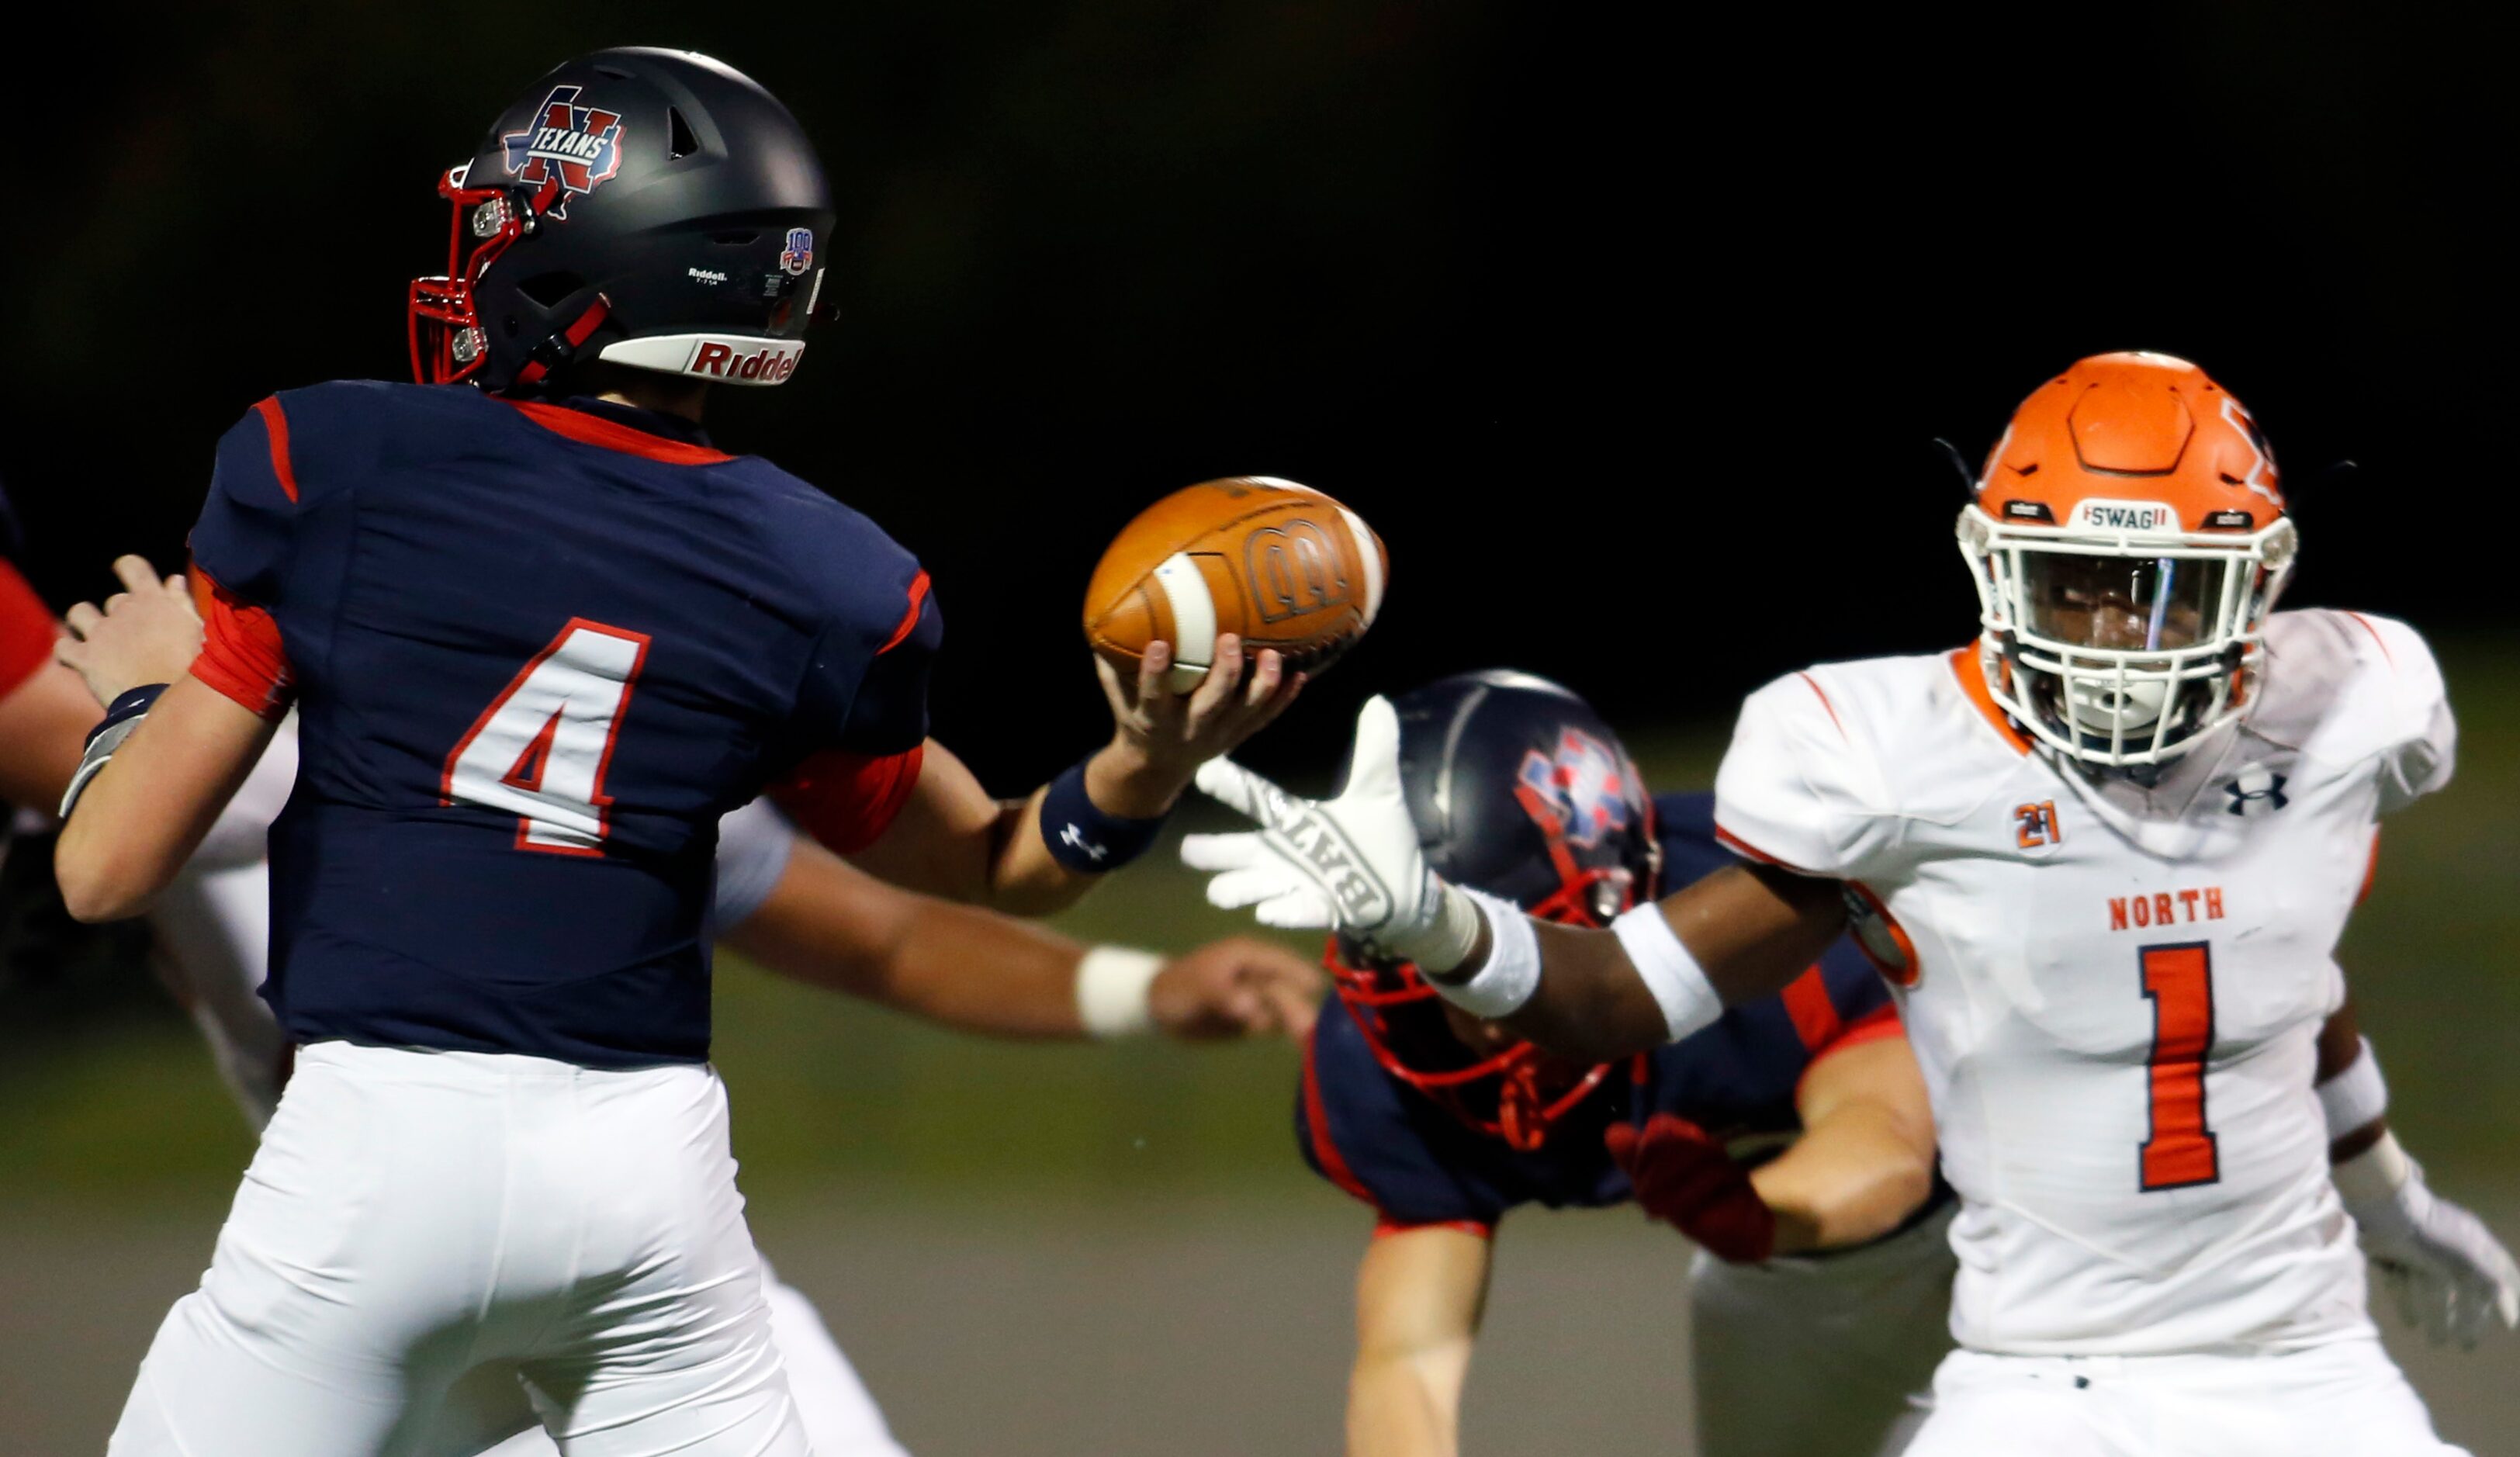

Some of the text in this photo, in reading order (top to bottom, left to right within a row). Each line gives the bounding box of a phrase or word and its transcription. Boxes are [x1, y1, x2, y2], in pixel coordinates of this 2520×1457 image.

[531, 127, 608, 159] TEXANS
[788, 232, 811, 251] 100
[688, 268, 725, 281] Riddell
[438, 616, 652, 857] 4
[2014, 799, 2061, 849] 21
[2107, 887, 2225, 930] NORTH
[2138, 940, 2219, 1192] 1
